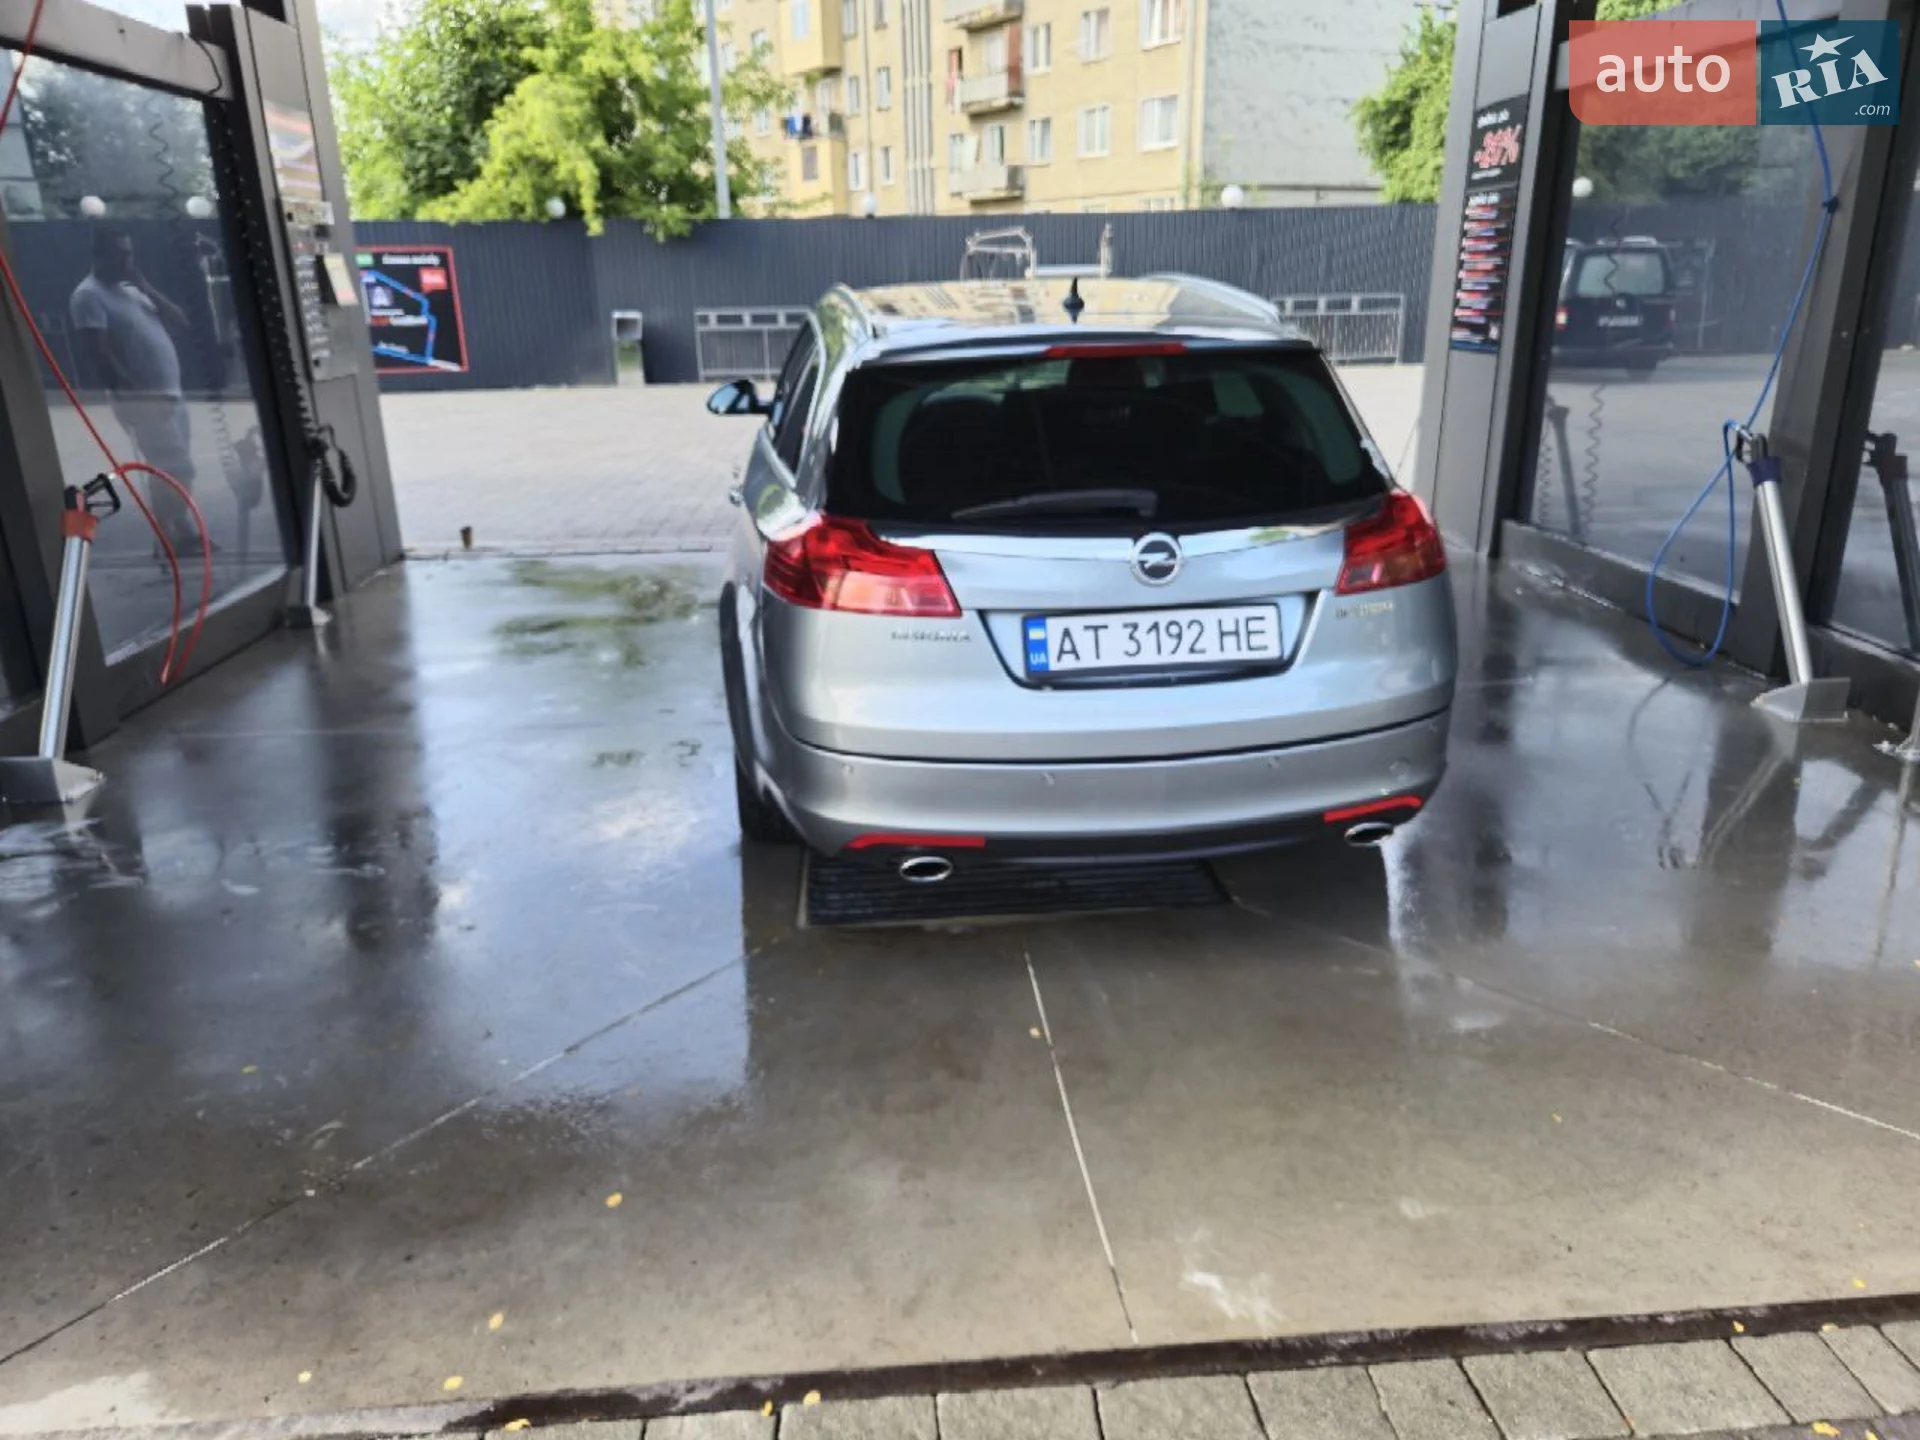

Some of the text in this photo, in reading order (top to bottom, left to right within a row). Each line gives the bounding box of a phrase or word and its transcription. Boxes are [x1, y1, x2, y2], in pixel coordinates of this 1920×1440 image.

[1056, 616, 1269, 663] AT 3192 HE
[1029, 653, 1047, 665] UA
